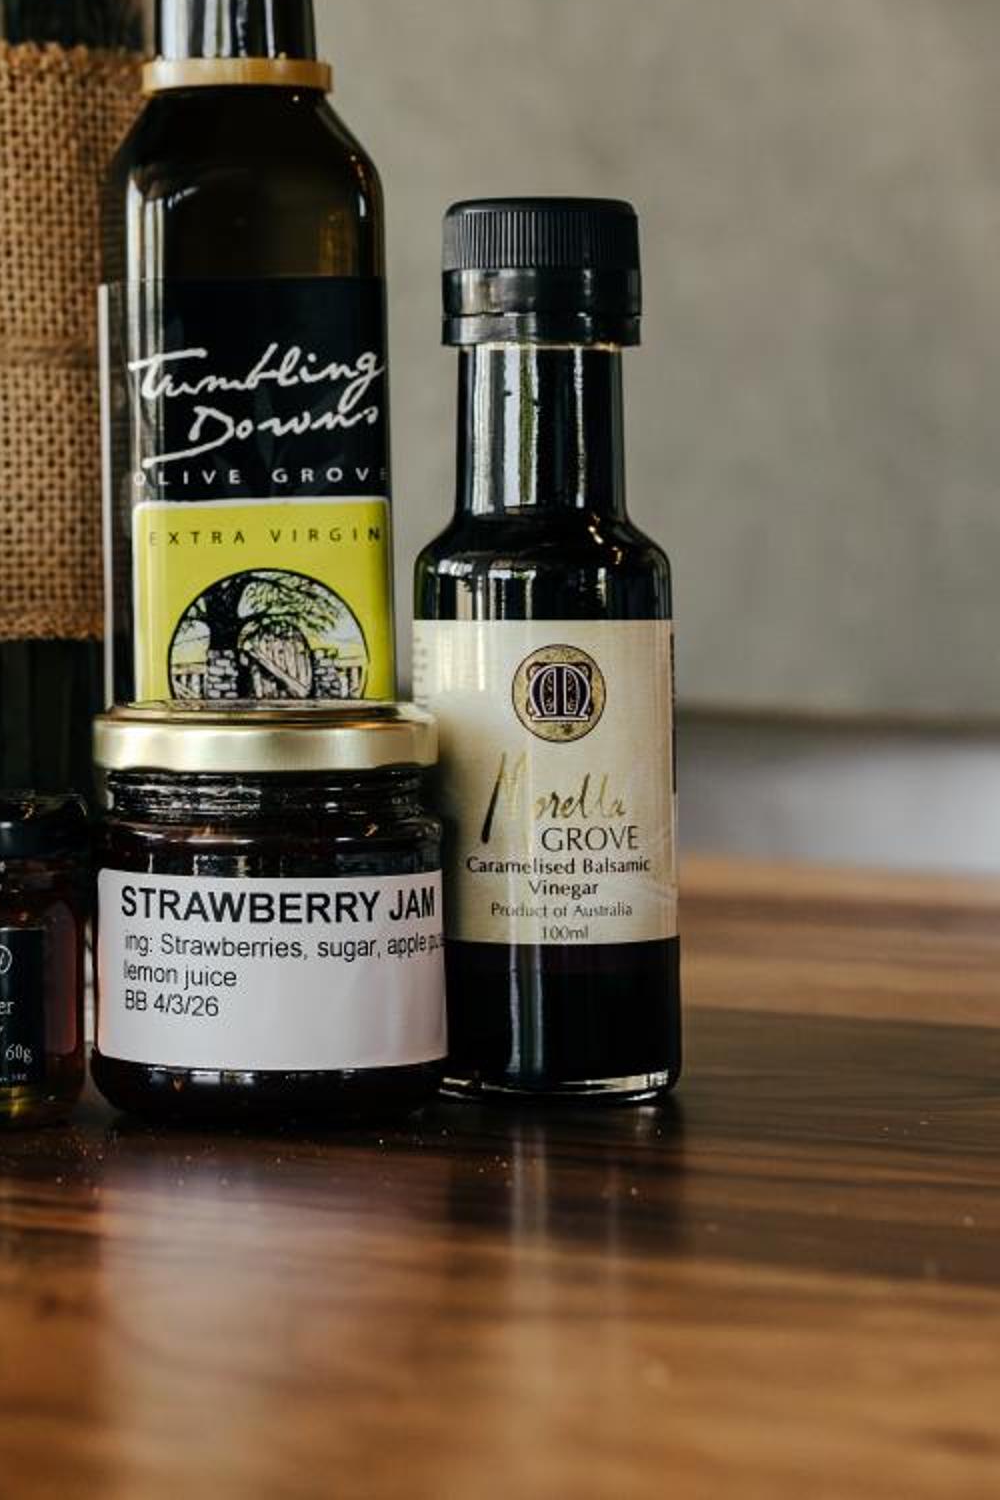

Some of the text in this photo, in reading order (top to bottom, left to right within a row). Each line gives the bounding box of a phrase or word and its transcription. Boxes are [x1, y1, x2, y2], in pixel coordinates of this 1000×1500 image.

[127, 342, 386, 411] Tumbling
[142, 405, 379, 469] Downs
[135, 469, 242, 486] OLIVE
[149, 527, 383, 546] EXTRA VIRGIN
[541, 825, 640, 852] GROVE
[466, 856, 652, 875] Caramelised Balsamic
[528, 879, 599, 900] Vinegar
[120, 884, 436, 924] STRAWBERRY JAM
[490, 901, 633, 917] Product of Australia
[541, 924, 589, 940] 100ml
[124, 932, 154, 957] ing:
[160, 932, 309, 961] Strawberries,
[317, 938, 382, 963] sugar,
[386, 931, 428, 958] apple
[123, 959, 238, 990] lemon juice
[124, 989, 220, 1017] BB 4/3/26
[4, 1043, 33, 1063] 60g
